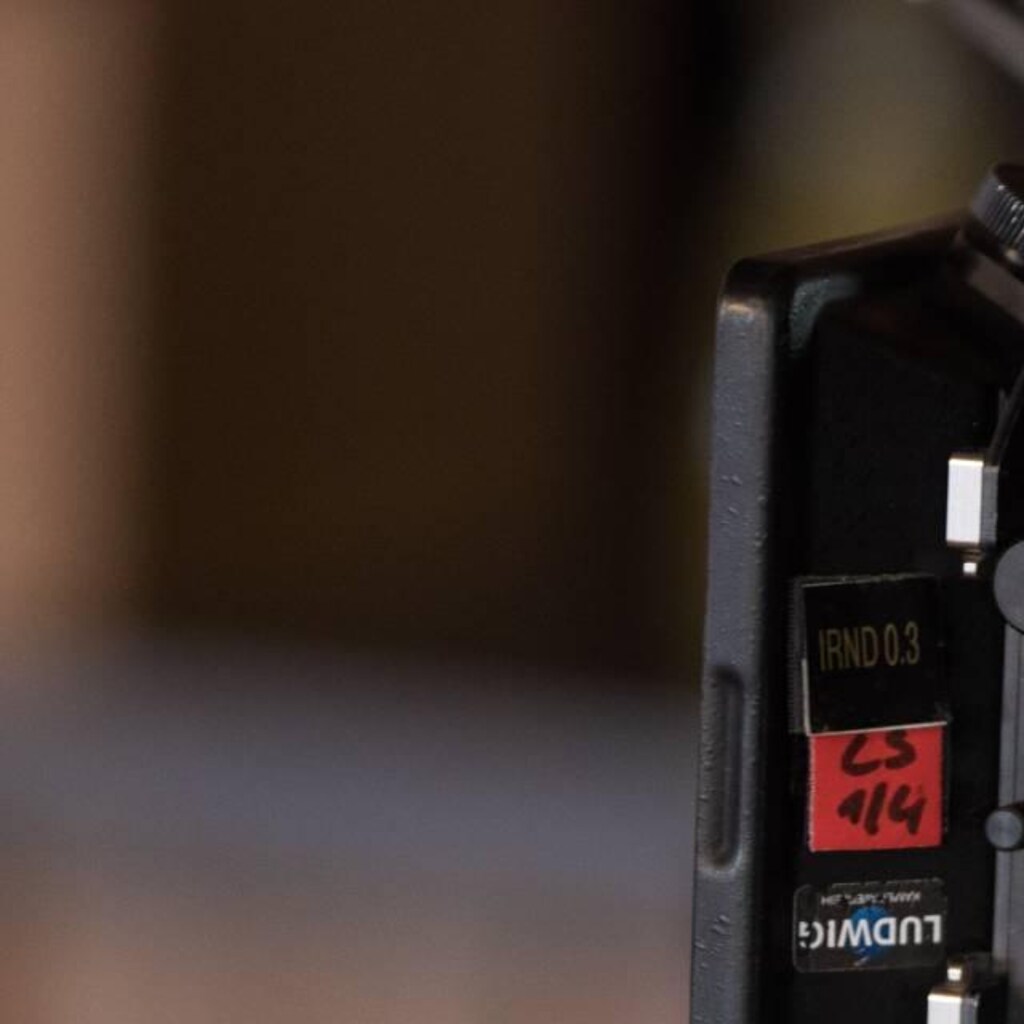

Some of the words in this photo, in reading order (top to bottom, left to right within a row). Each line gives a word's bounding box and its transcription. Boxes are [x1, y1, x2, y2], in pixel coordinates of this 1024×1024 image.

[818, 625, 878, 671] IRND
[884, 621, 921, 667] 0.3
[798, 915, 942, 949] LUDWIG
